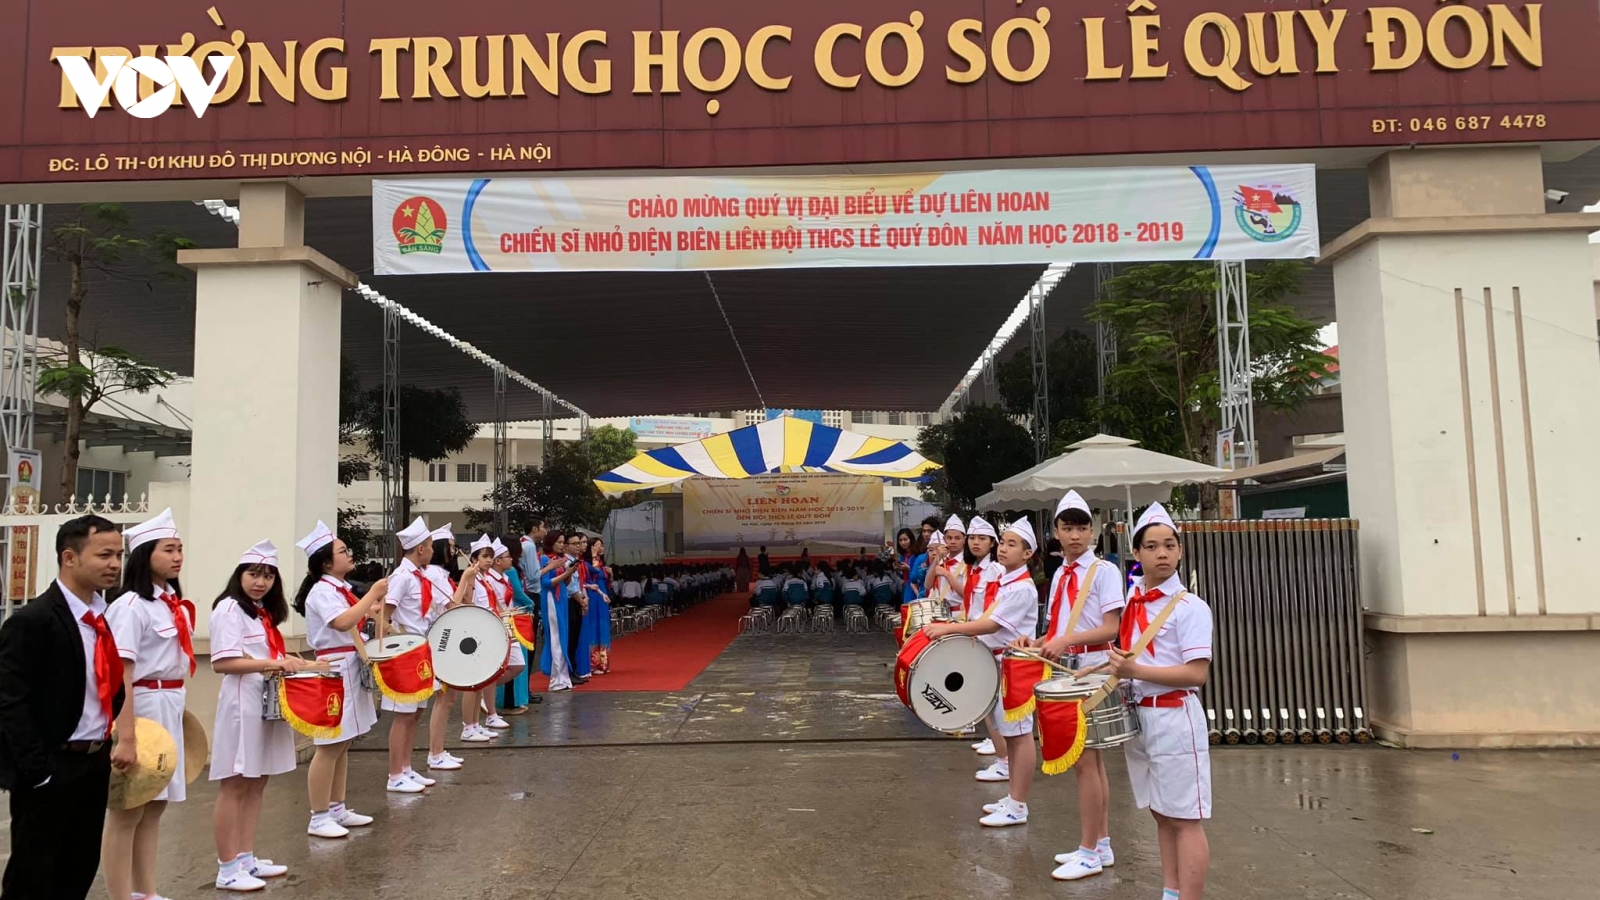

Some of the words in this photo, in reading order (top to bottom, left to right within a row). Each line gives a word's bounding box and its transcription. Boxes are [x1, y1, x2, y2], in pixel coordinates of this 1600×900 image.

[369, 30, 612, 101] TRUNG
[632, 25, 793, 115] HỌC
[814, 6, 924, 88] CƠ
[1081, 0, 1169, 80] LÊ
[1184, 0, 1348, 91] QUÝ
[1372, 119, 1402, 133] ĐT:
[1410, 117, 1448, 132] 046
[1455, 116, 1492, 130] 687
[1500, 114, 1547, 129] 4478
[49, 157, 80, 172] ĐC:
[85, 154, 109, 171] LÔ
[168, 154, 205, 169] KHU
[209, 151, 236, 168] ĐÔ
[240, 152, 267, 170] THỊ
[271, 150, 337, 166] DƯƠNG
[341, 146, 372, 167] NỘI
[388, 145, 413, 163] HÀ
[418, 144, 470, 162] ĐÔNG
[490, 144, 517, 161] HÀ
[521, 143, 552, 163] NỘI
[628, 196, 678, 219] CHÀO
[683, 193, 740, 218] MỪNG
[745, 195, 781, 218] QUÝ
[785, 195, 804, 220] VỊ
[808, 193, 839, 218] ĐẠI
[844, 187, 886, 216] BIỂU
[892, 186, 914, 214] VỀ
[919, 191, 948, 218] DỰ
[949, 187, 992, 213] LIÊN
[996, 190, 1050, 212] HOAN
[500, 226, 556, 254] CHIẾN
[561, 227, 581, 252] SĨ
[585, 225, 624, 252] NHỎ
[628, 227, 672, 256] ĐIỆN
[677, 226, 720, 252] BIÊN
[725, 226, 767, 251] LIÊN
[771, 226, 802, 255] ĐỘI
[807, 228, 855, 249] THCS
[859, 223, 882, 248] LÊ
[886, 223, 921, 248] QUÝ
[927, 223, 968, 247] ĐÔN
[978, 220, 1024, 246] NĂM
[1028, 223, 1067, 250] HỌC
[1073, 223, 1119, 244] 2018
[1137, 221, 1184, 243] 2019
[747, 496, 777, 505] LIÊN
[781, 496, 819, 504] HOAN
[437, 628, 451, 652] YAMAHA
